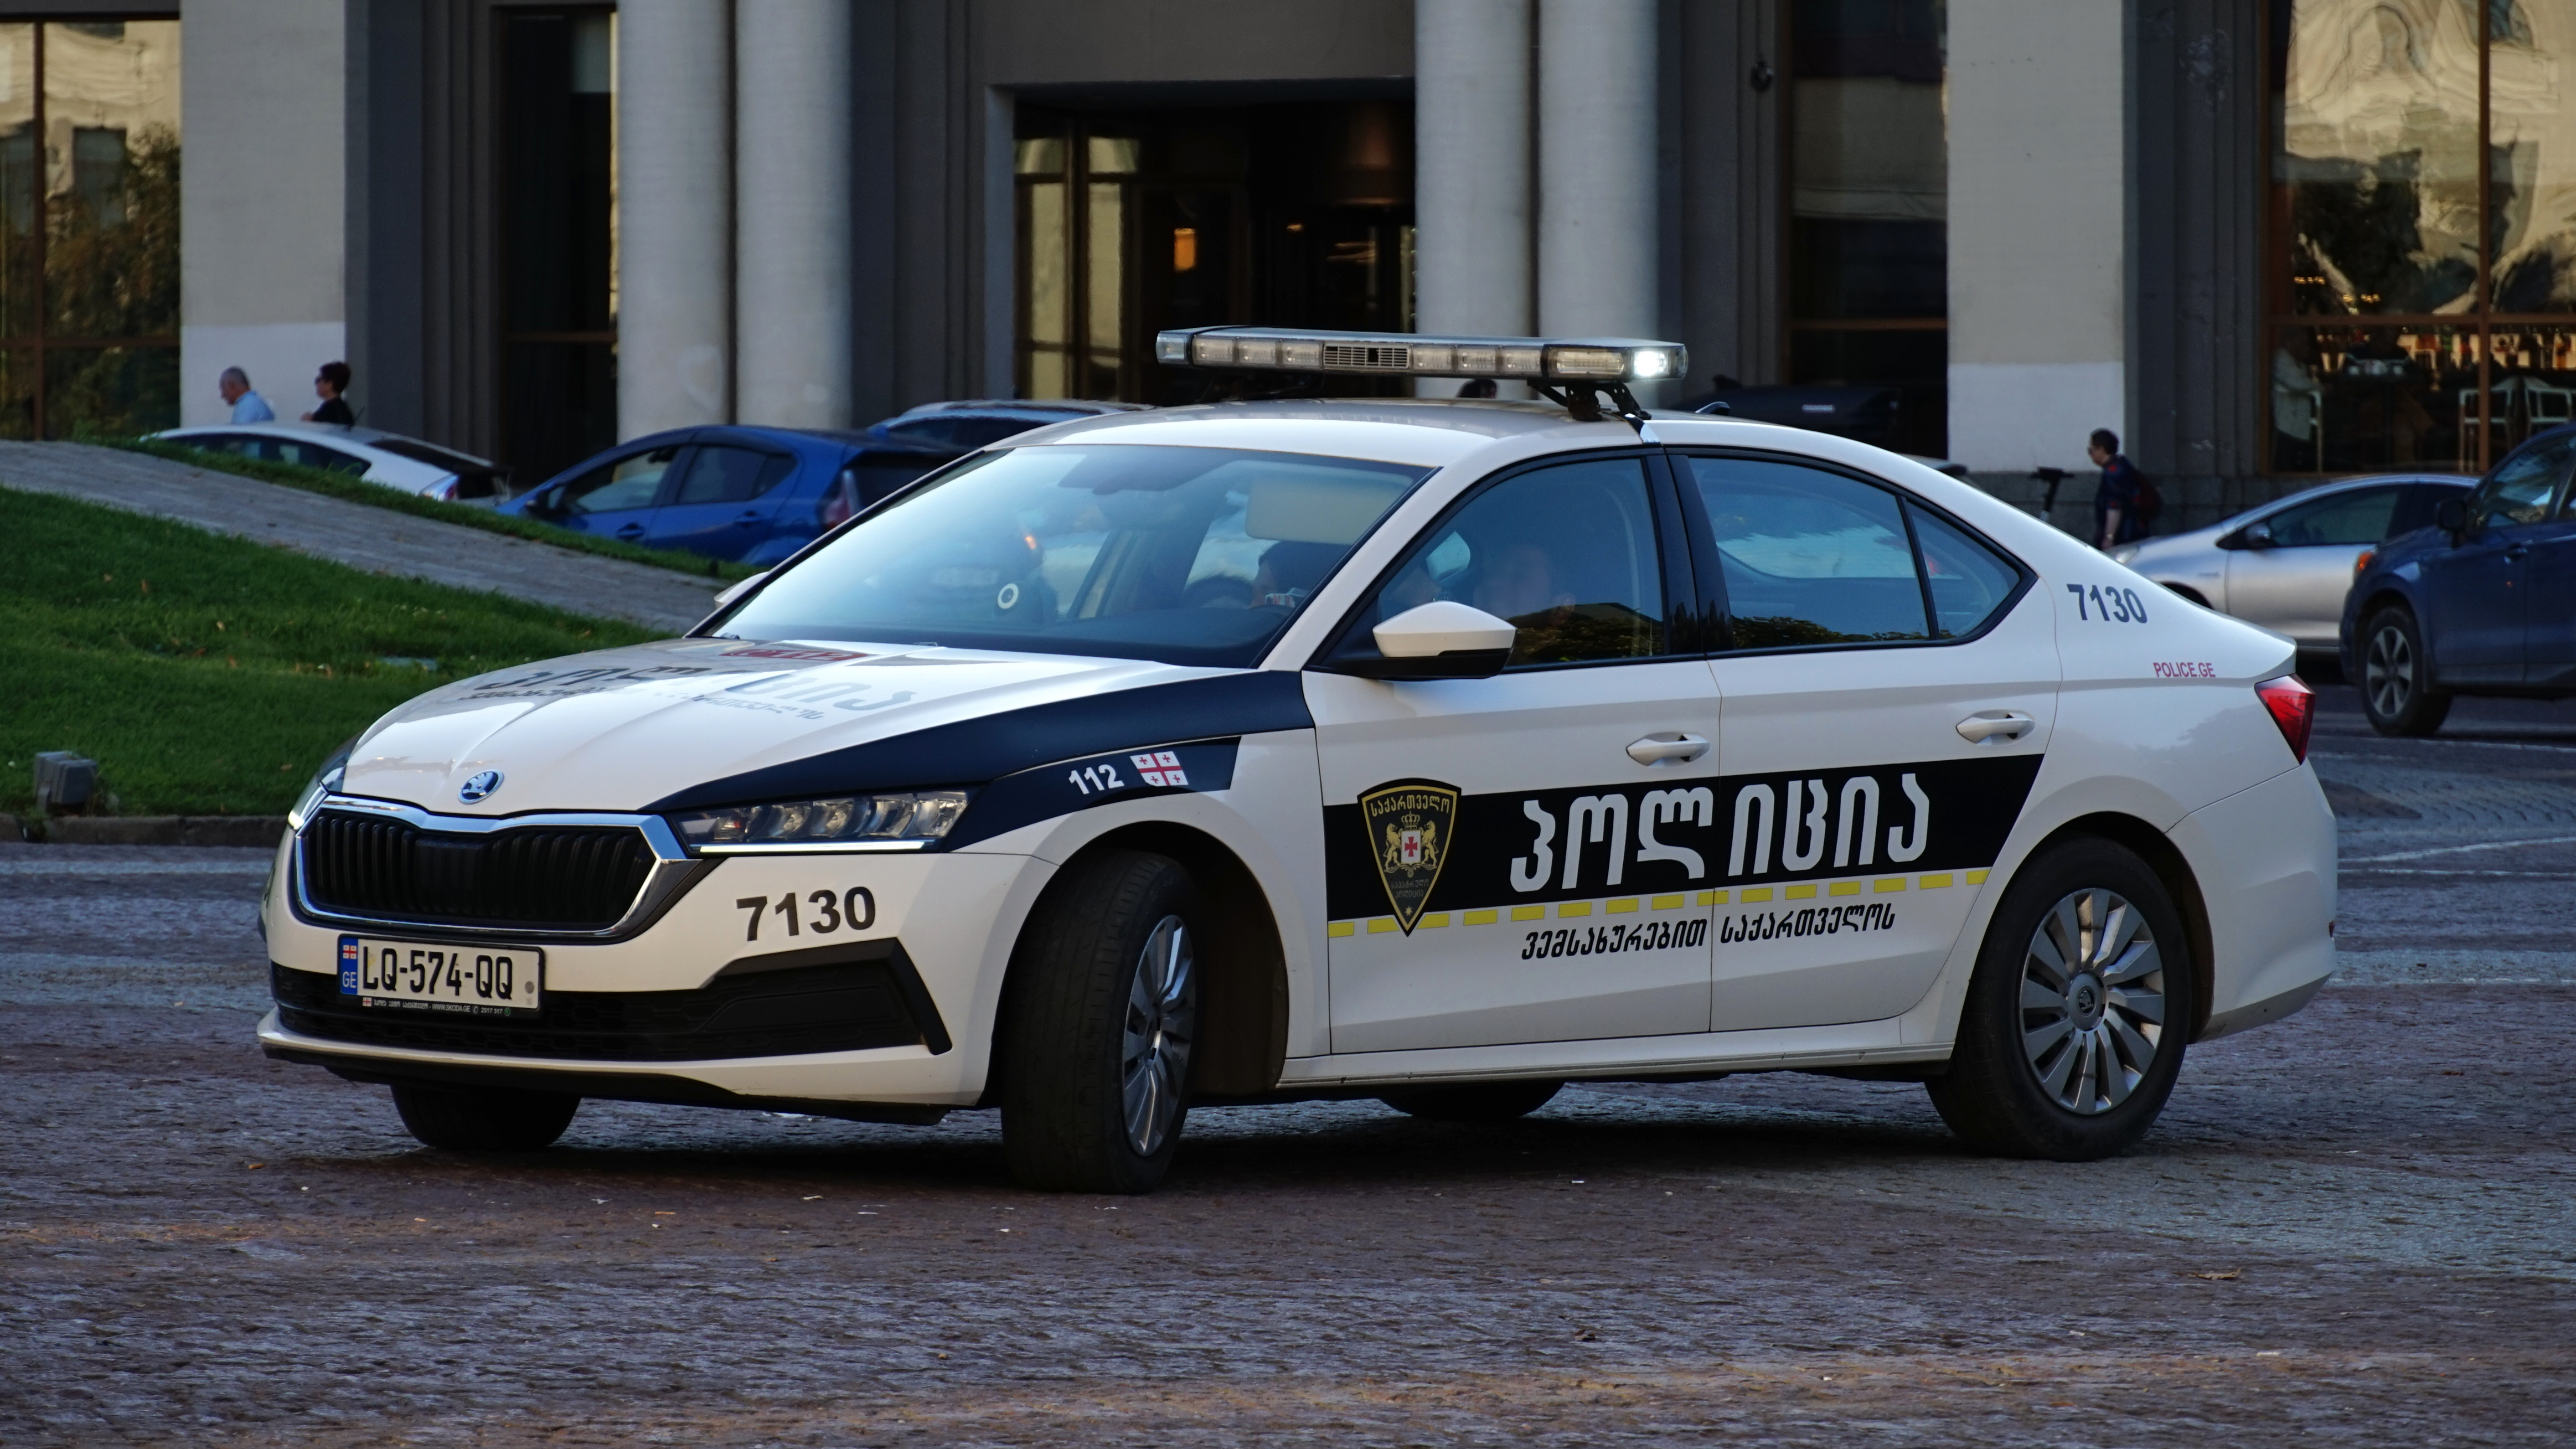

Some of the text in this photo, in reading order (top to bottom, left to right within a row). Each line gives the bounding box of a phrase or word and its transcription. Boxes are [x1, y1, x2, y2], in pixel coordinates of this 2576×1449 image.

[2066, 583, 2147, 624] 7130
[2153, 662, 2216, 678] POLICE.GE
[1068, 764, 1124, 795] 112
[1370, 794, 1450, 817] საქართველო
[1510, 773, 1930, 893] პოლიცია
[736, 886, 875, 942] 7130
[1521, 903, 1896, 960] ვემსახურებით საქართველოს
[342, 971, 357, 989] GE
[363, 946, 513, 1000] LQ-574-QQ
